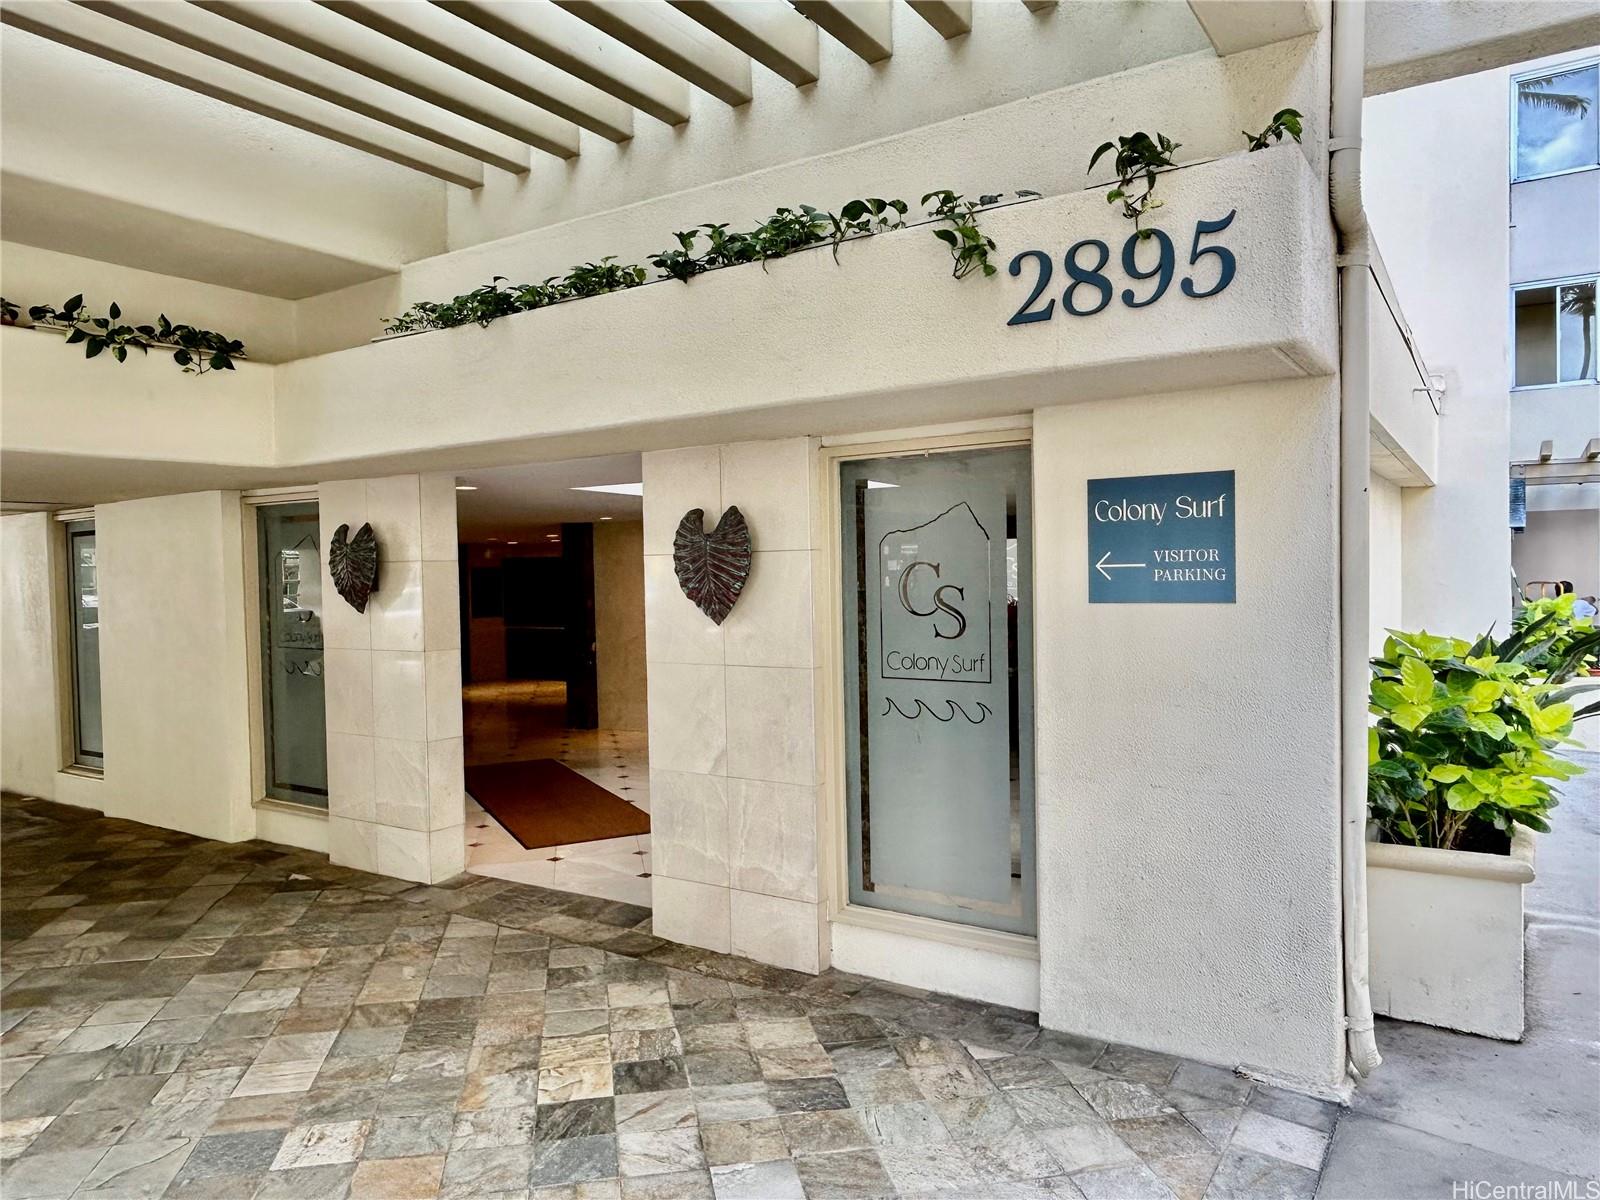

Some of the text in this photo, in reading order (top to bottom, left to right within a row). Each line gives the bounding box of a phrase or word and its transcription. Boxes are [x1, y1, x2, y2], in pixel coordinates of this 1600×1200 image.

[1007, 209, 1237, 326] 2895
[1094, 493, 1227, 526] Colony Surf
[1153, 548, 1220, 563] VISITOR
[1153, 567, 1227, 582] PARKING
[886, 650, 986, 679] Colony Surf
